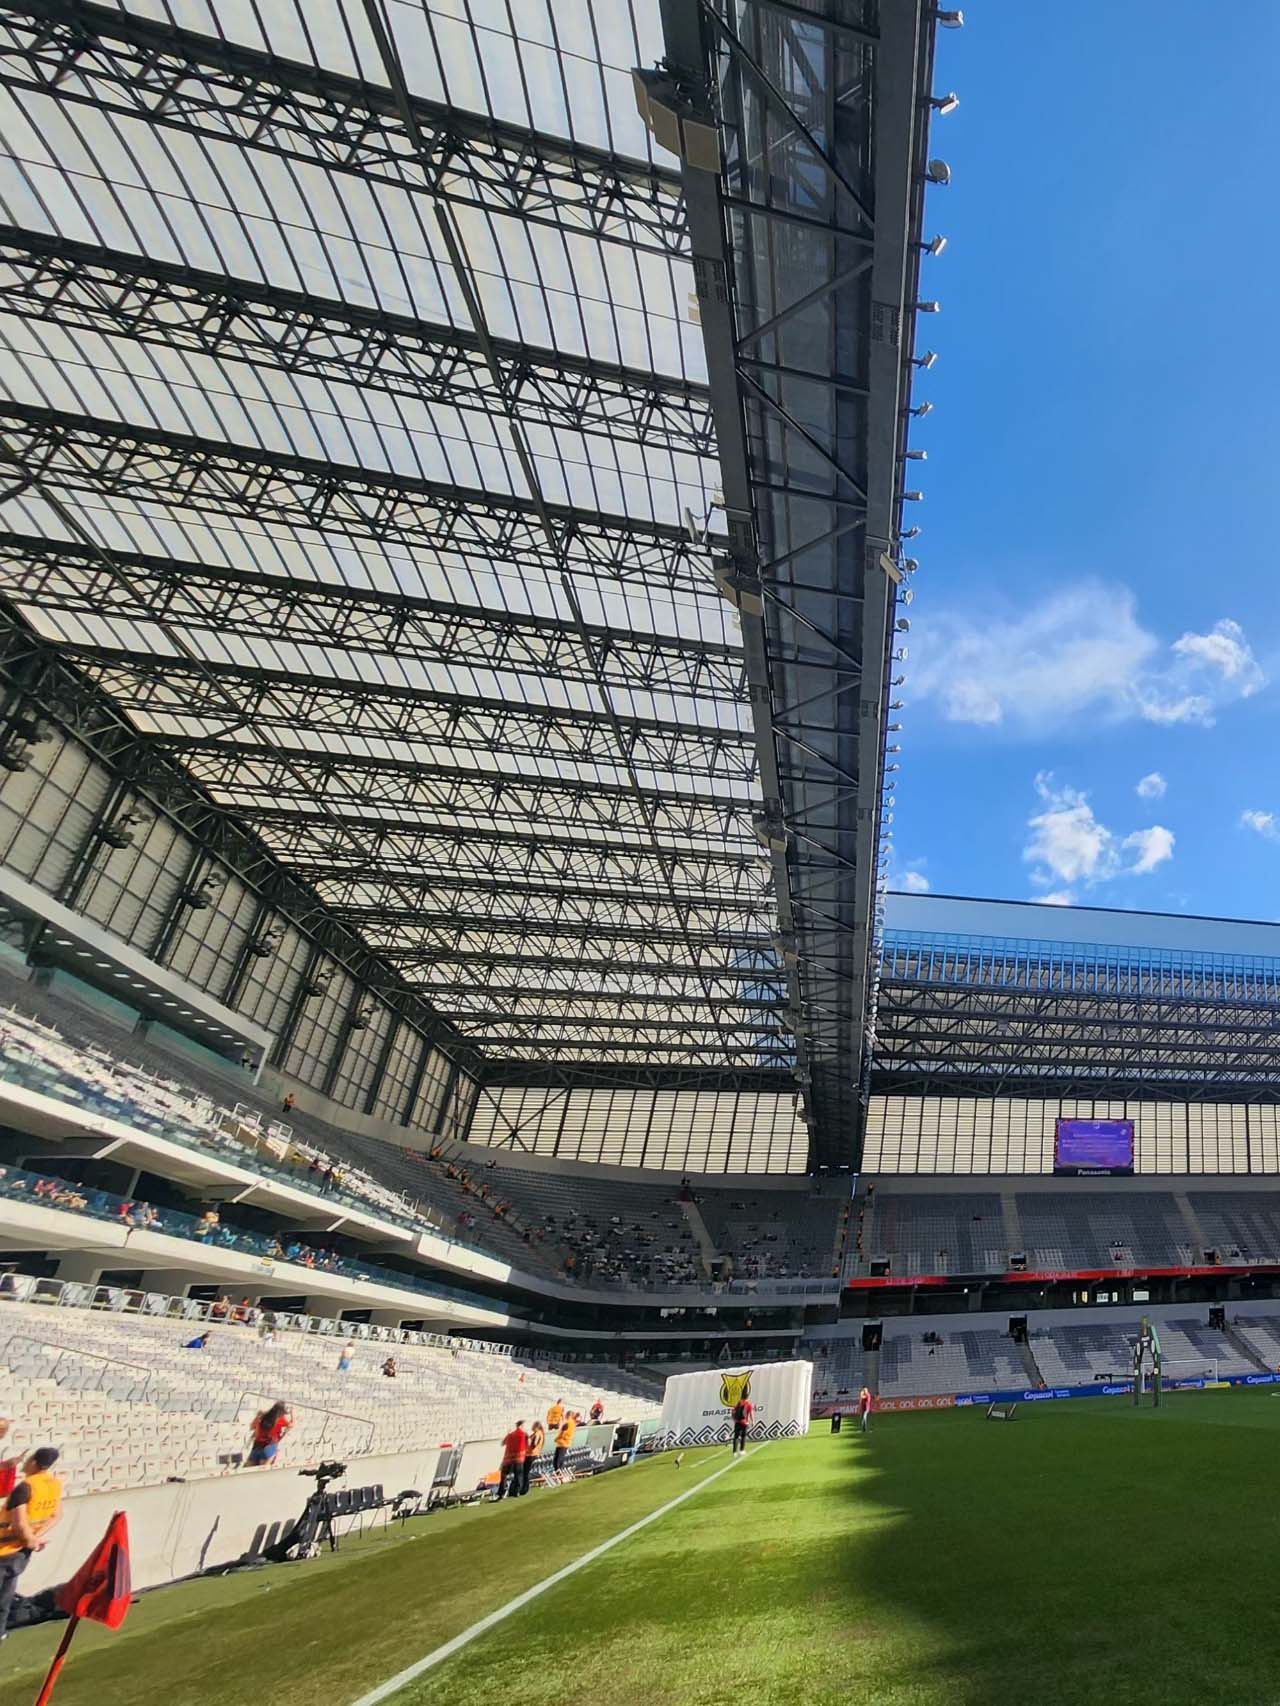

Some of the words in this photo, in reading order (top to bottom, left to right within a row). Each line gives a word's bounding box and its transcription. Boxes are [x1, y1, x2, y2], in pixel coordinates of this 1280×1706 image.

[1024, 1390, 1054, 1401] Copacol
[880, 1400, 896, 1410] GOL
[900, 1399, 915, 1408] GOL
[919, 1398, 934, 1407] GOL
[936, 1397, 952, 1406] GOL
